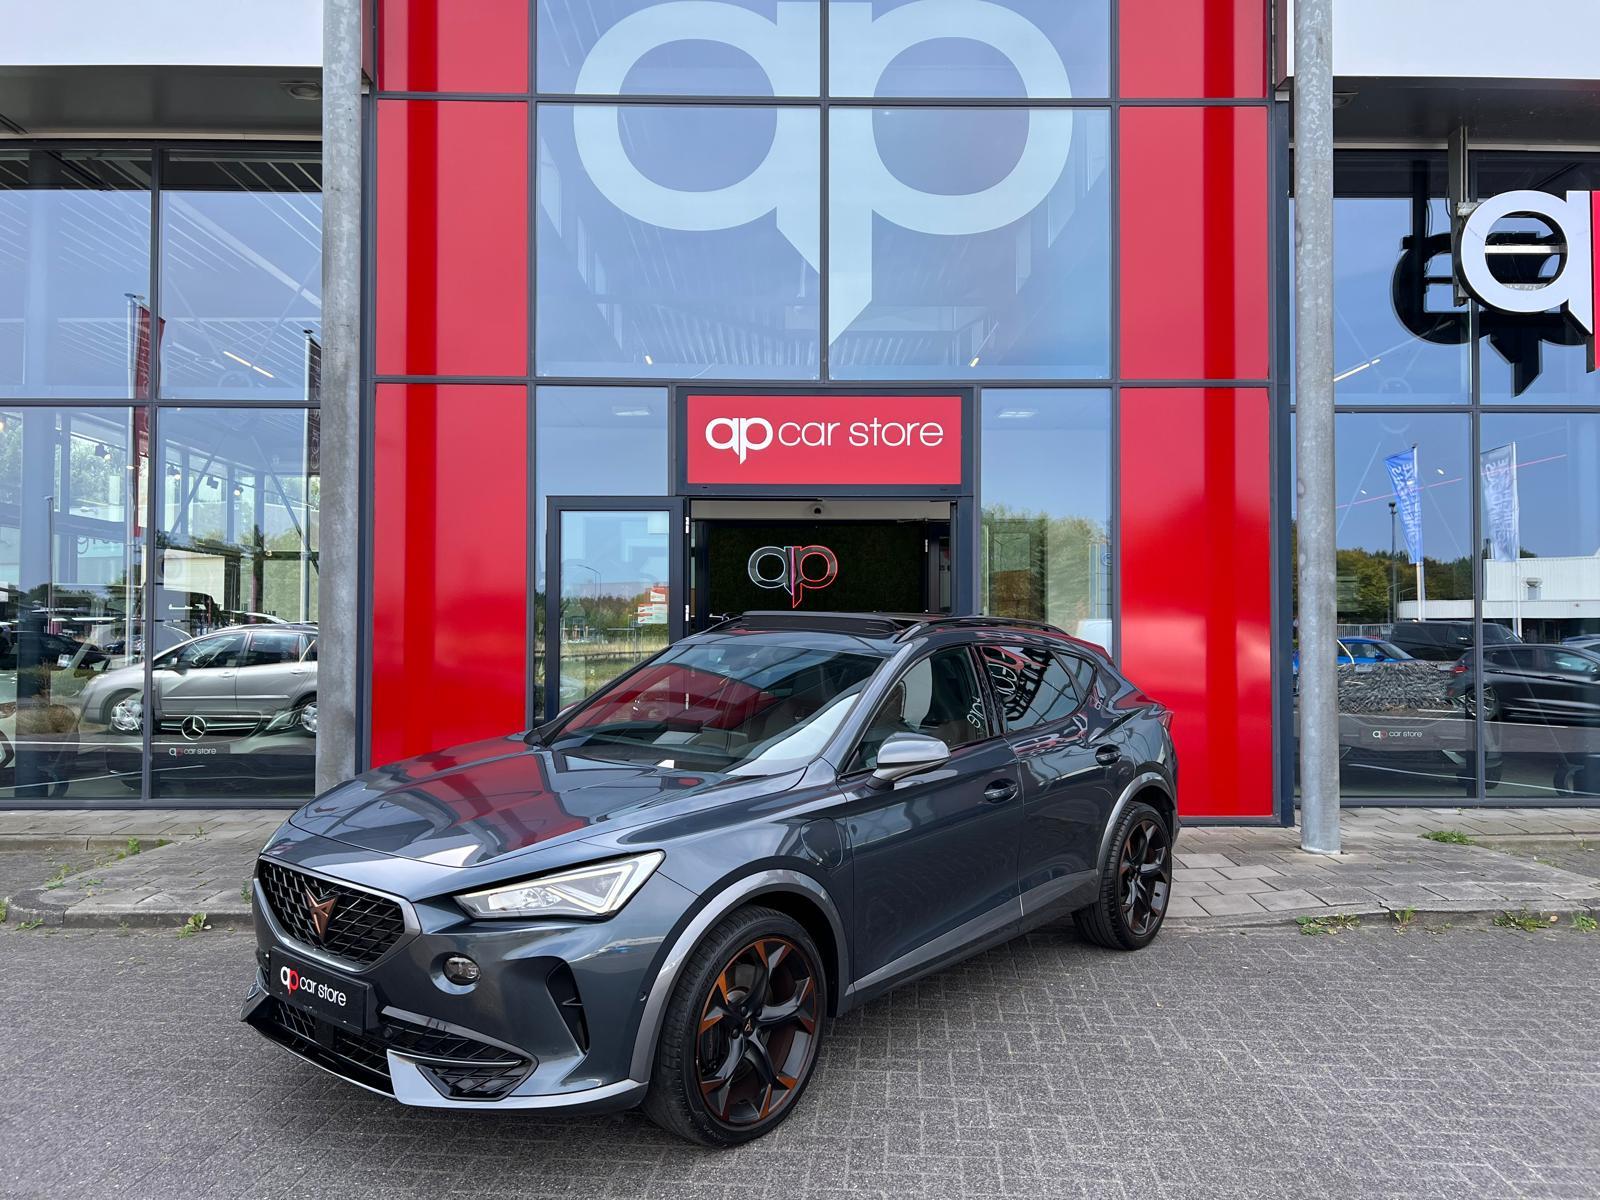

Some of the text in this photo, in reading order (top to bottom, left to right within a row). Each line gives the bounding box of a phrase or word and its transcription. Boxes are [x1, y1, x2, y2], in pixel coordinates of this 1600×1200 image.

[778, 422, 840, 446] car
[849, 417, 943, 446] store
[1402, 730, 1422, 738] store
[197, 747, 217, 755] store
[299, 976, 317, 994] car
[317, 984, 347, 1007] store
